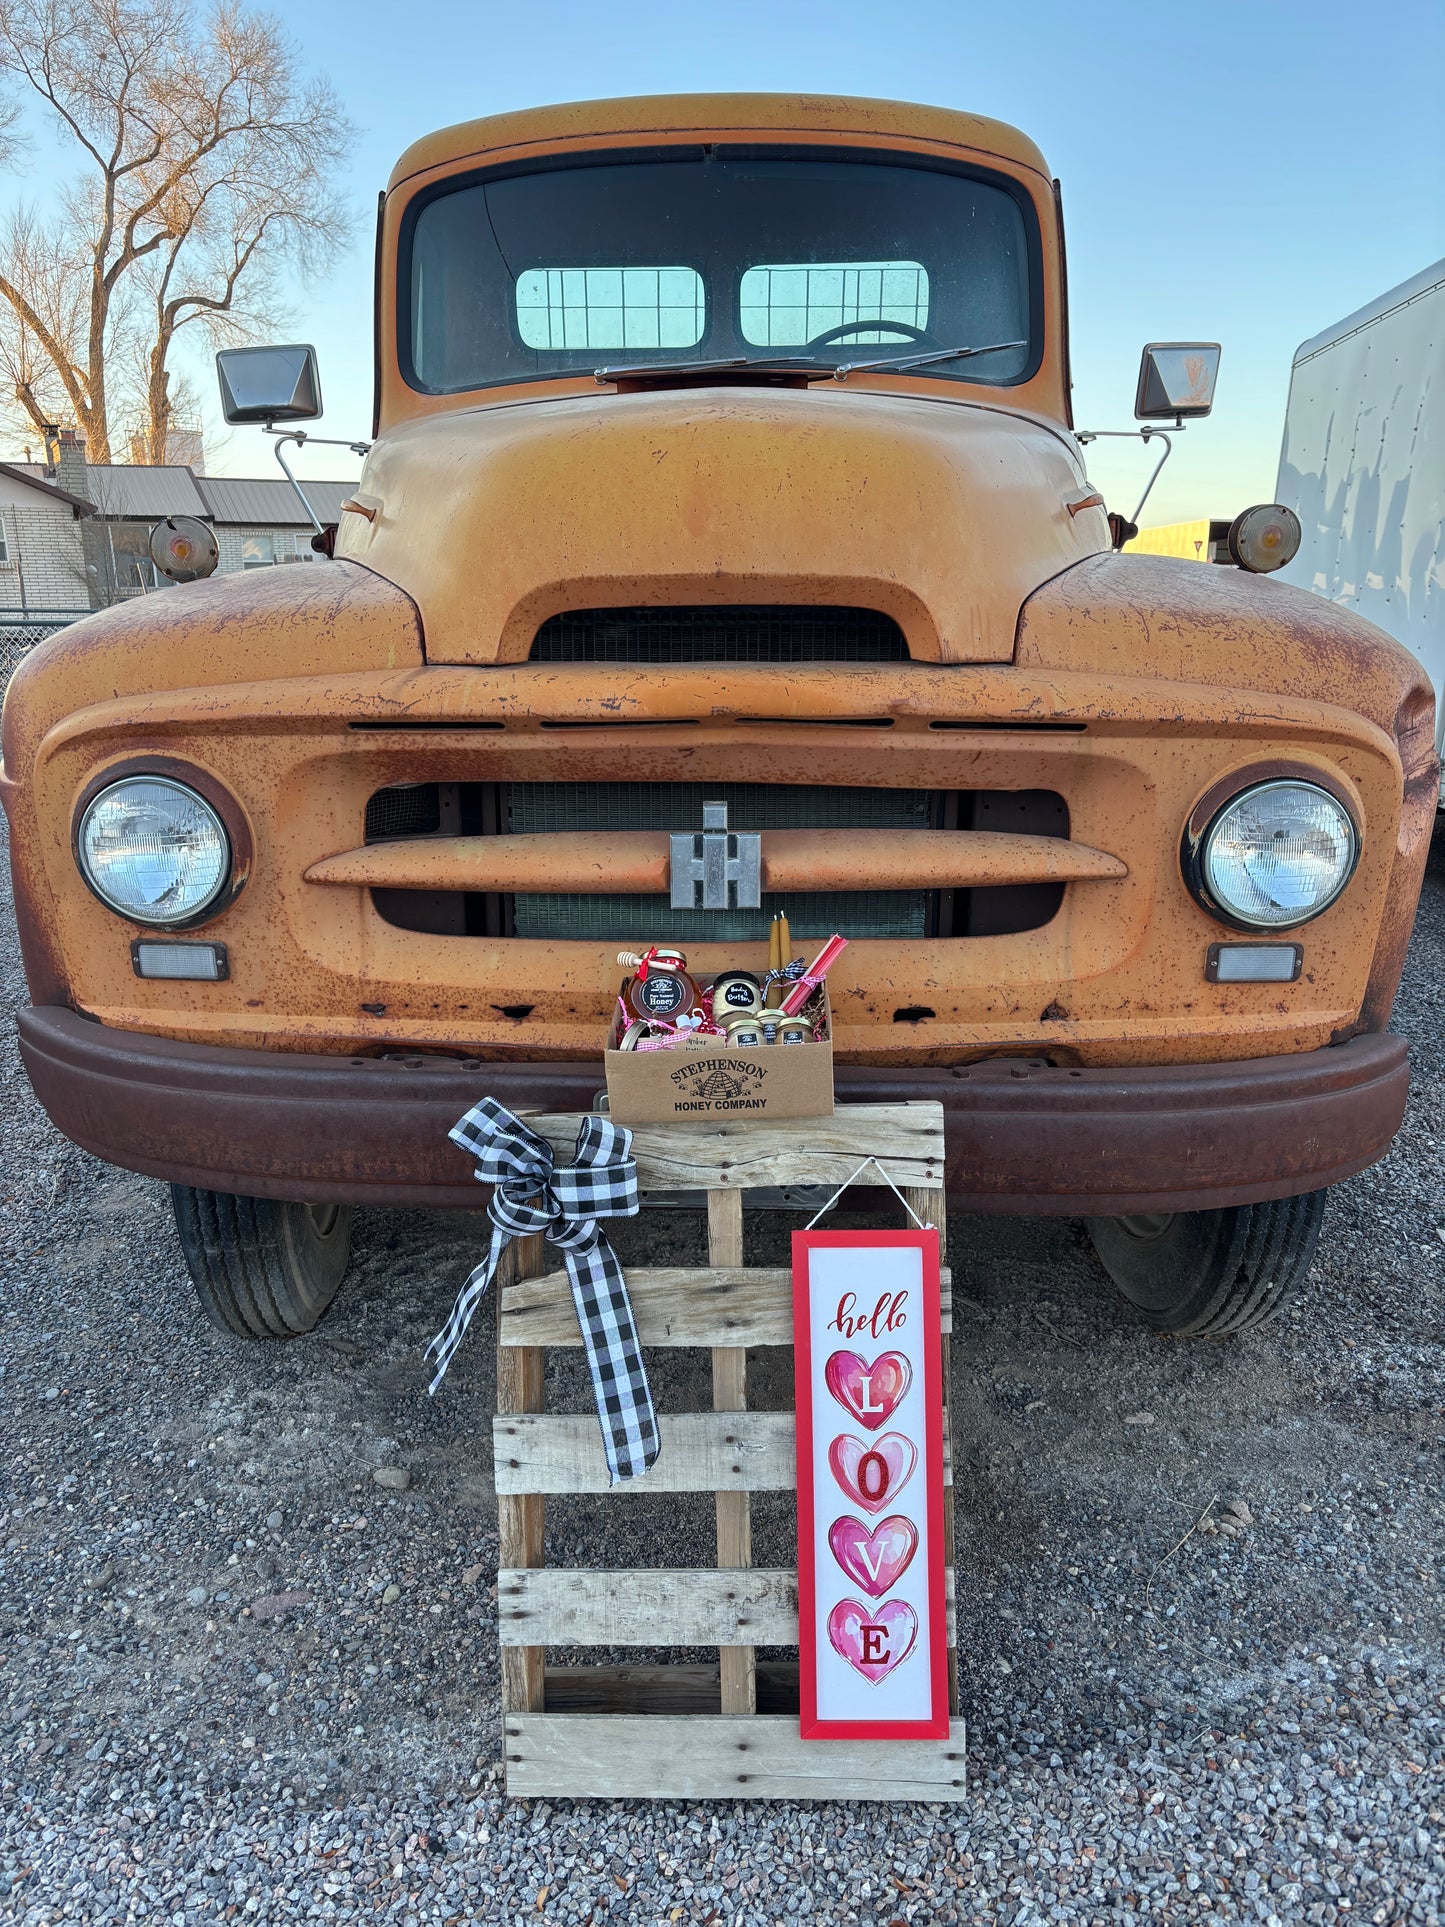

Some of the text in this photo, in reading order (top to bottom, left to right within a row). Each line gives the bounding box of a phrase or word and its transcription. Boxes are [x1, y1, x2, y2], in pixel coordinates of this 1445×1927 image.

[650, 998, 674, 1007] Honey
[670, 1059, 768, 1084] STEPHENSON
[674, 1098, 768, 1112] HONEY COMPANY
[827, 1290, 909, 1339] hello
